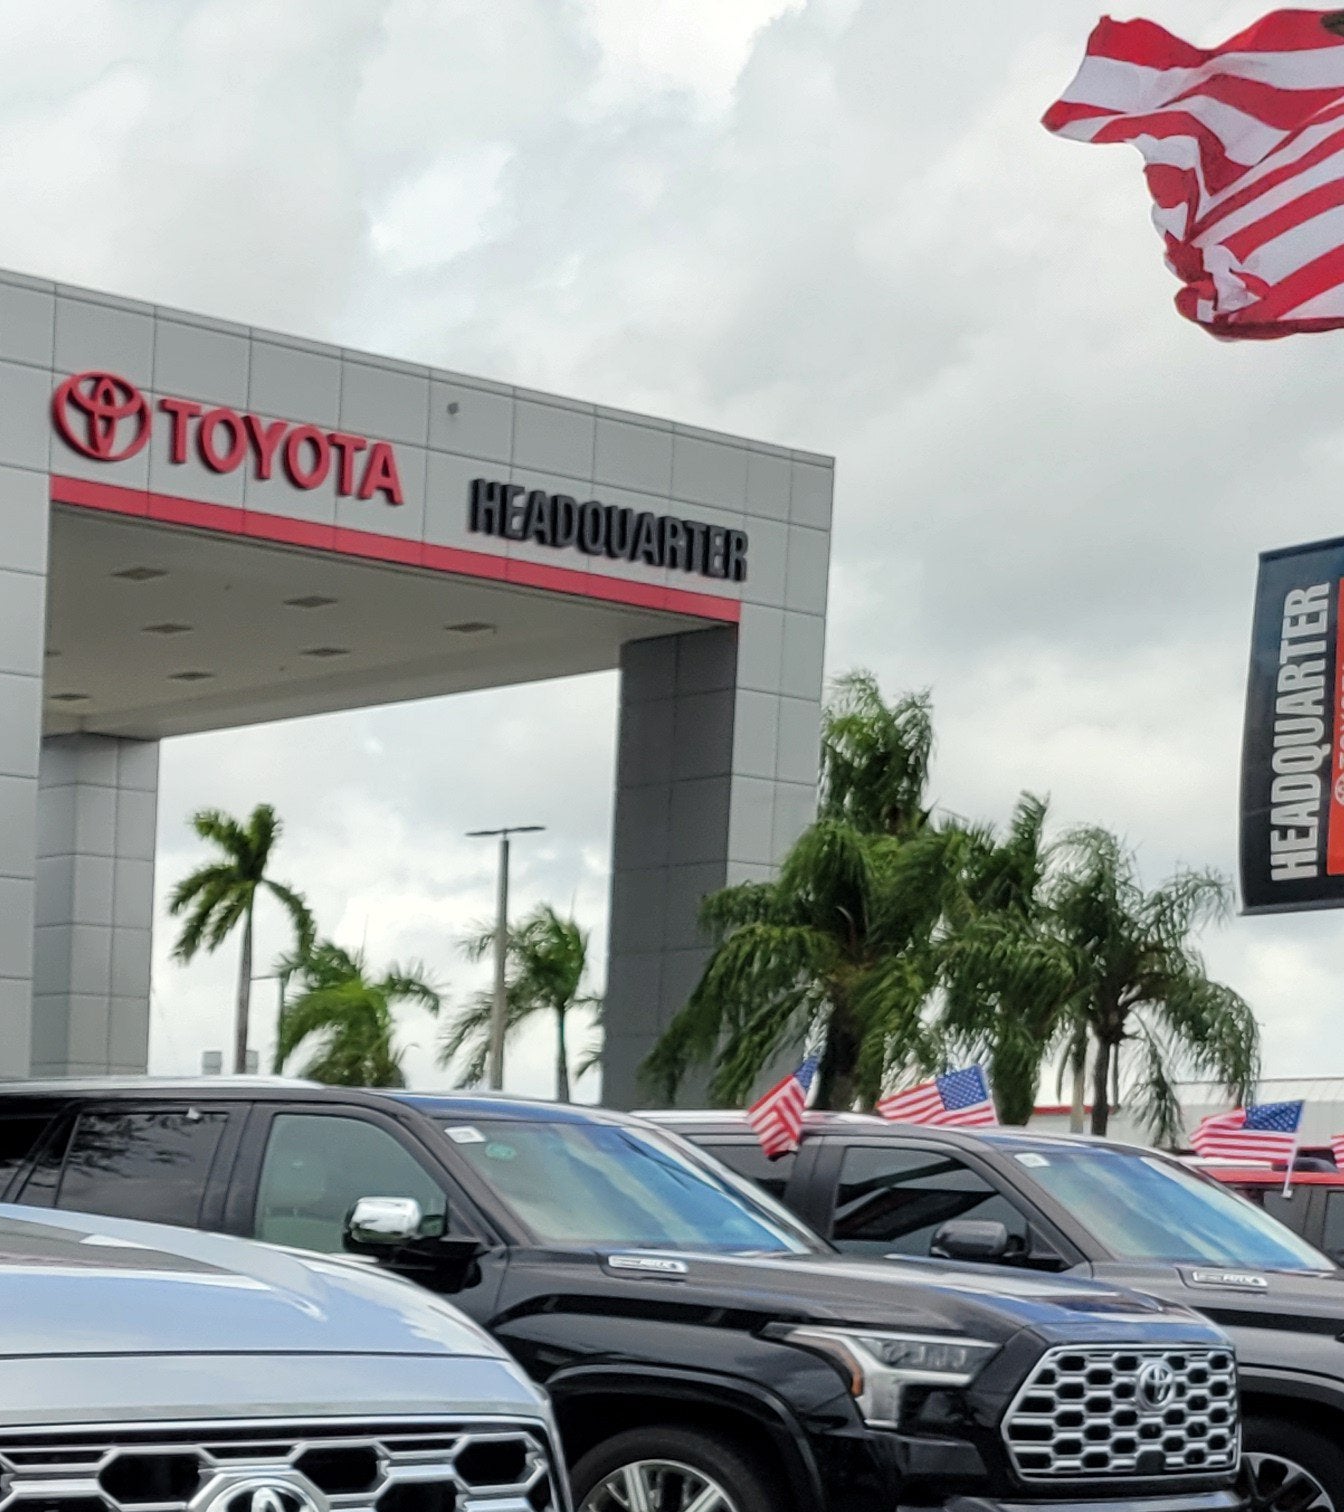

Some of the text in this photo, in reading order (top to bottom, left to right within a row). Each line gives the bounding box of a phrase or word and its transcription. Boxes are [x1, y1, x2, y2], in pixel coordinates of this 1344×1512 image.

[159, 398, 749, 583] TOYOTA HEADQUARTER
[1269, 581, 1332, 882] HEADQUARTER
